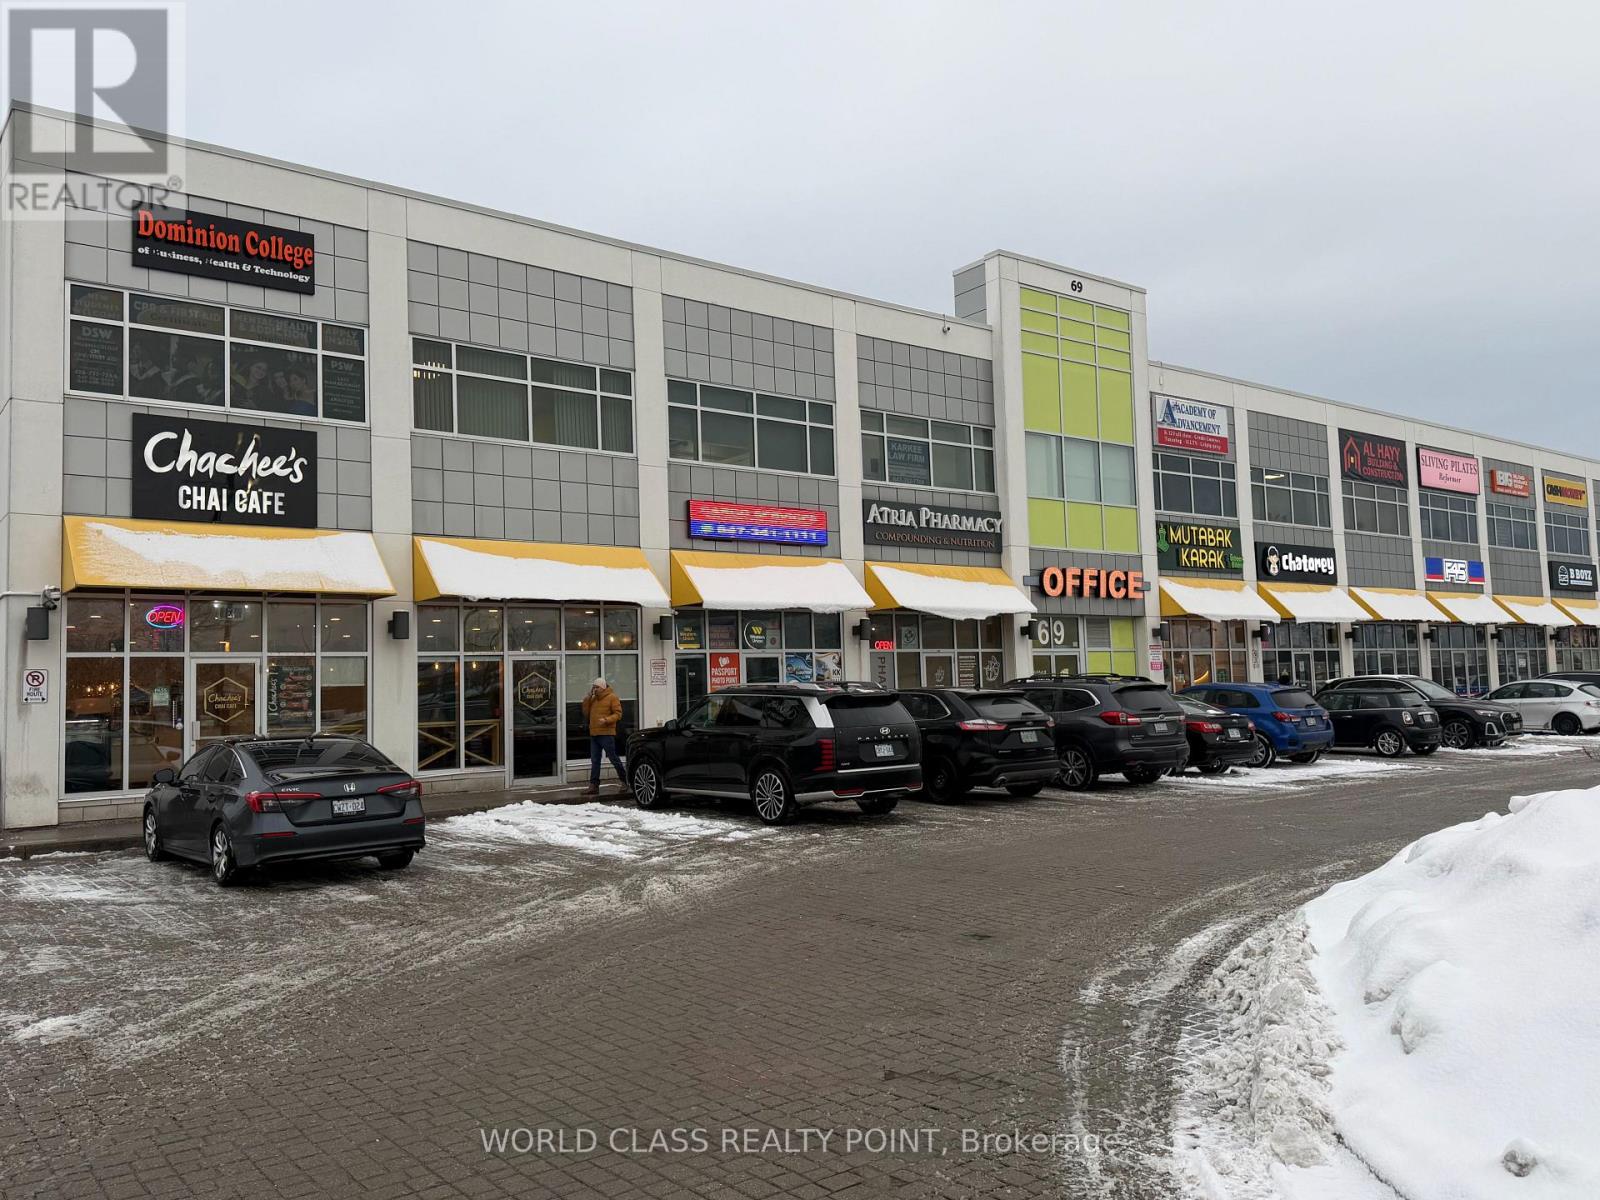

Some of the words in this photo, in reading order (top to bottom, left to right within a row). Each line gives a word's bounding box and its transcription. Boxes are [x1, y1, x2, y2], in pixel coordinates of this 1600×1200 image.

[138, 209, 240, 253] Dominion
[245, 230, 313, 270] College
[138, 246, 150, 255] of
[152, 248, 203, 265] uiness,
[242, 263, 253, 272] &
[253, 264, 310, 283] Technology
[1071, 280, 1083, 293] 69
[82, 326, 112, 340] DSW
[331, 360, 354, 371] PSW
[1177, 403, 1208, 418] ACADEMY
[1207, 408, 1217, 420] OF
[144, 427, 308, 484] Chachee's
[889, 451, 905, 461] LAW
[907, 452, 926, 465] FIRM
[1363, 440, 1375, 458] AL
[1377, 443, 1401, 463] HAYY
[1367, 457, 1393, 470] BUILDING
[1421, 454, 1449, 471] SLIVING
[1451, 460, 1478, 475] PILATES
[1439, 473, 1462, 484] Reformer
[178, 485, 228, 512] CHAI
[234, 488, 286, 515] CAFE
[866, 503, 918, 529] ATRIA
[919, 507, 1003, 533] PHARMACY
[875, 531, 942, 546] COMPOUNDING
[950, 537, 995, 549] NUTRITION
[1169, 524, 1233, 548] MUTABAK
[1182, 547, 1226, 569] KARAK
[1282, 552, 1335, 576] Chatorey
[1043, 567, 1144, 599] OFFICE
[1569, 568, 1575, 579] B
[1575, 568, 1593, 581] BOYZ
[148, 611, 181, 623] OPEN
[1037, 619, 1065, 645] 69
[874, 640, 894, 650] OPEN
[711, 667, 737, 677] PASSPORT
[711, 676, 725, 684] PHOTO
